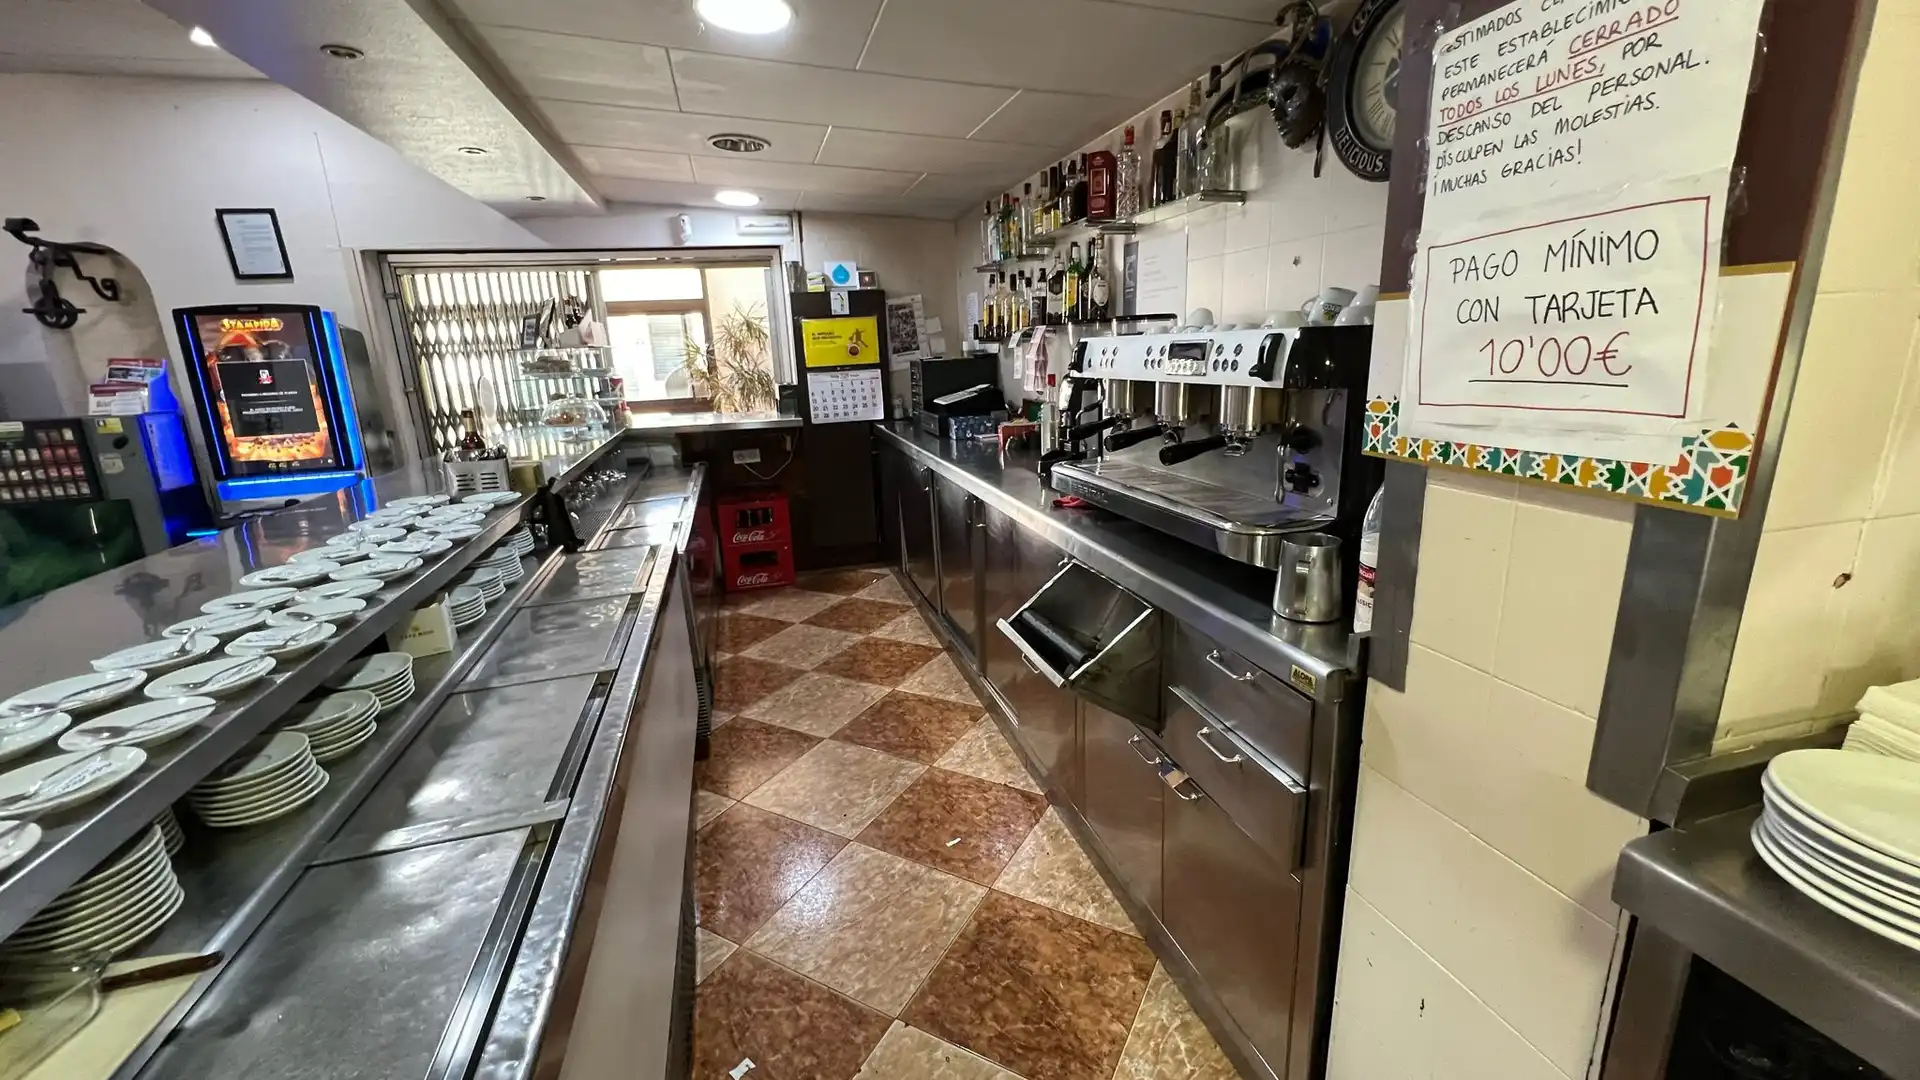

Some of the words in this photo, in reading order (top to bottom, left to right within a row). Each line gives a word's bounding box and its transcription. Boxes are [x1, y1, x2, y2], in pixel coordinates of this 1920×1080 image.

[1440, 97, 1483, 122] TODOS
[1495, 81, 1520, 104] LOS
[1535, 55, 1606, 93] LUNES,
[1622, 32, 1662, 60] POR
[1442, 39, 1555, 100] PERMANECERÁ
[1568, 0, 1680, 56] CERRADO
[1444, 53, 1480, 79] ESTE
[1436, 112, 1512, 146] DESCANSO
[1531, 96, 1563, 118] DEL
[1587, 49, 1709, 103] PERSONAL.
[1436, 139, 1504, 170] DISCULPEN
[1514, 129, 1539, 149] LAS
[1554, 91, 1660, 136] MOLESTIAS.
[1501, 138, 1582, 179] GRACIAS!
[1449, 249, 1519, 285] PAGO
[1544, 228, 1660, 273] MÍNIMO
[1457, 298, 1500, 325] CON
[1524, 286, 1660, 325] TARJETA
[1479, 331, 1633, 378] 10'00€
